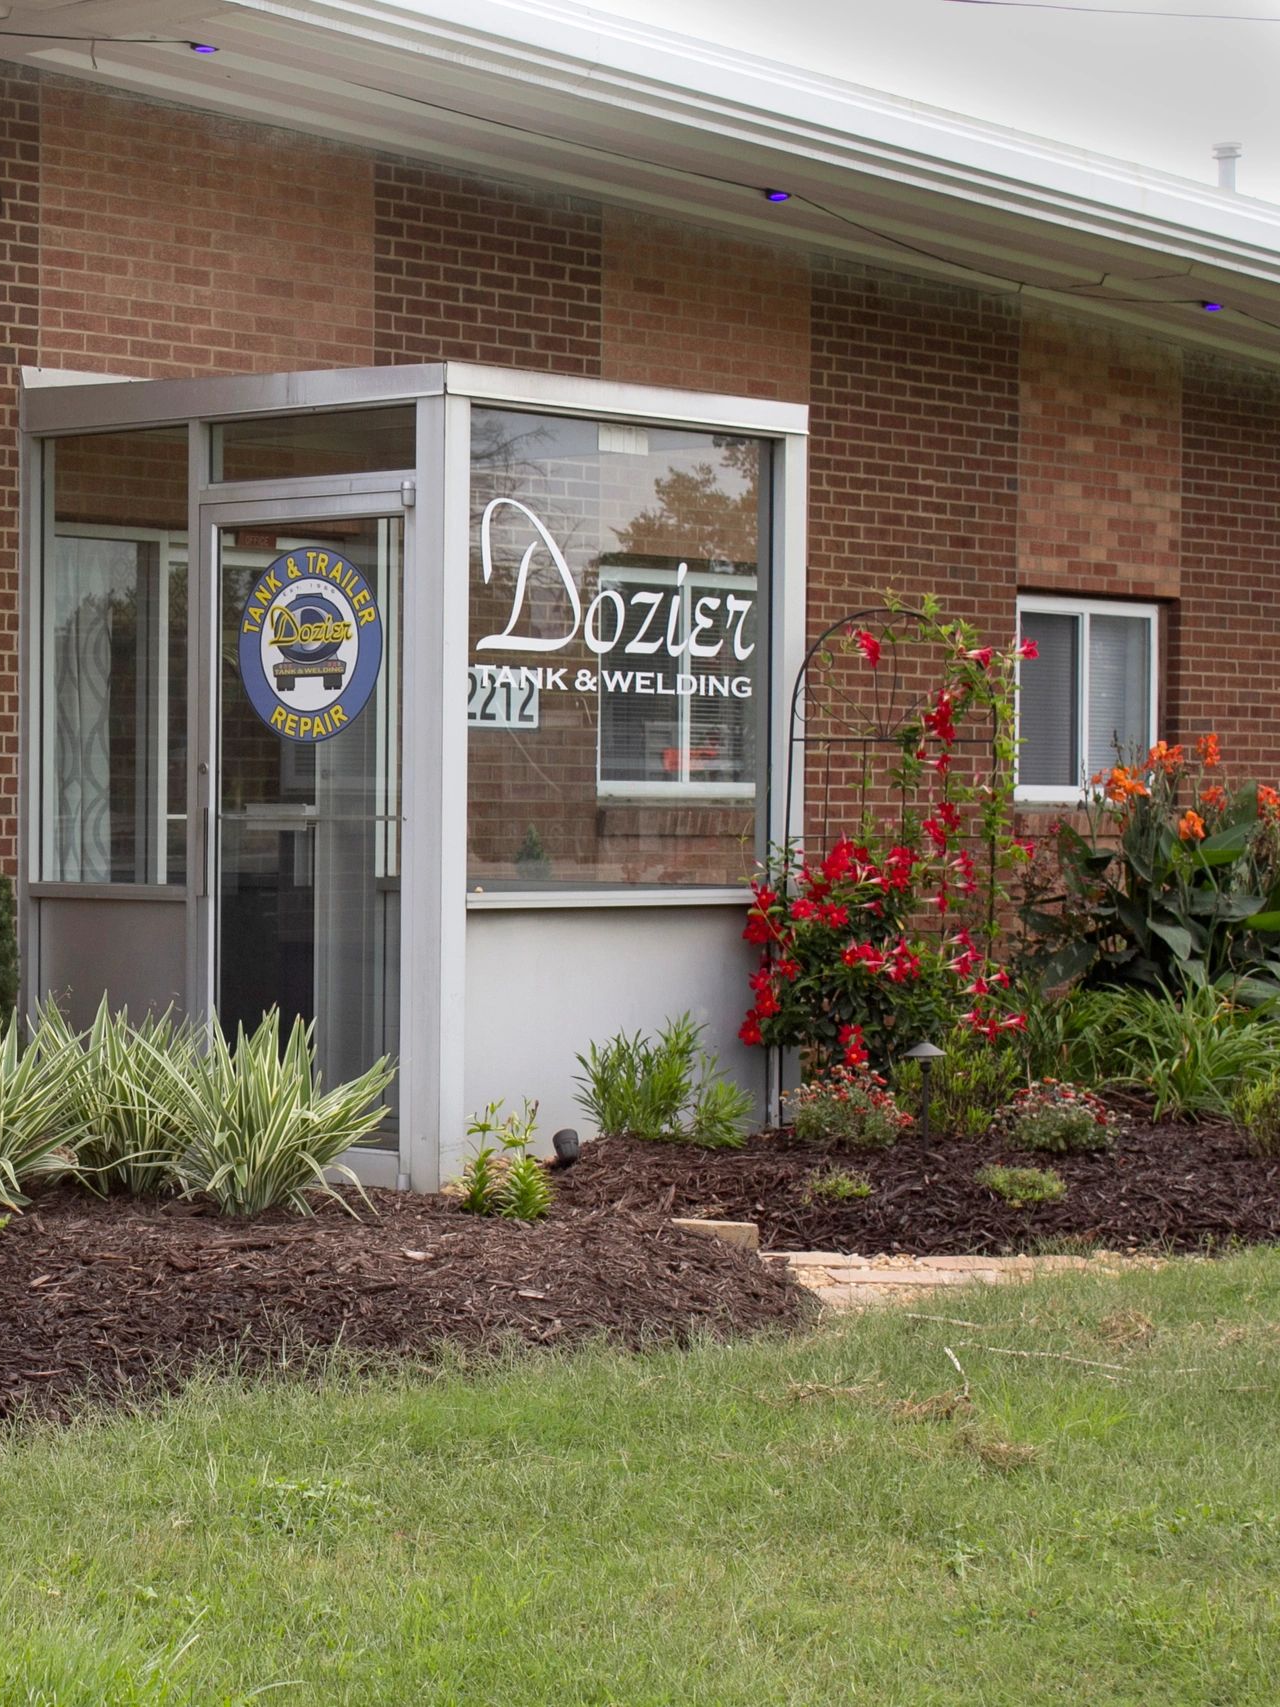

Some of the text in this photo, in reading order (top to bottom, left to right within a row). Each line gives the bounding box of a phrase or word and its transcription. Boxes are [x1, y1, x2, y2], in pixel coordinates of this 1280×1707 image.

[242, 551, 377, 634] TANK & TRAILER
[476, 497, 755, 661] Dozier
[268, 605, 353, 647] Dozier
[274, 668, 296, 676] TANK
[304, 666, 344, 675] WELDING
[475, 664, 753, 699] TANK & WELDING
[468, 671, 535, 723] 2212
[270, 704, 349, 739] REPAIR
